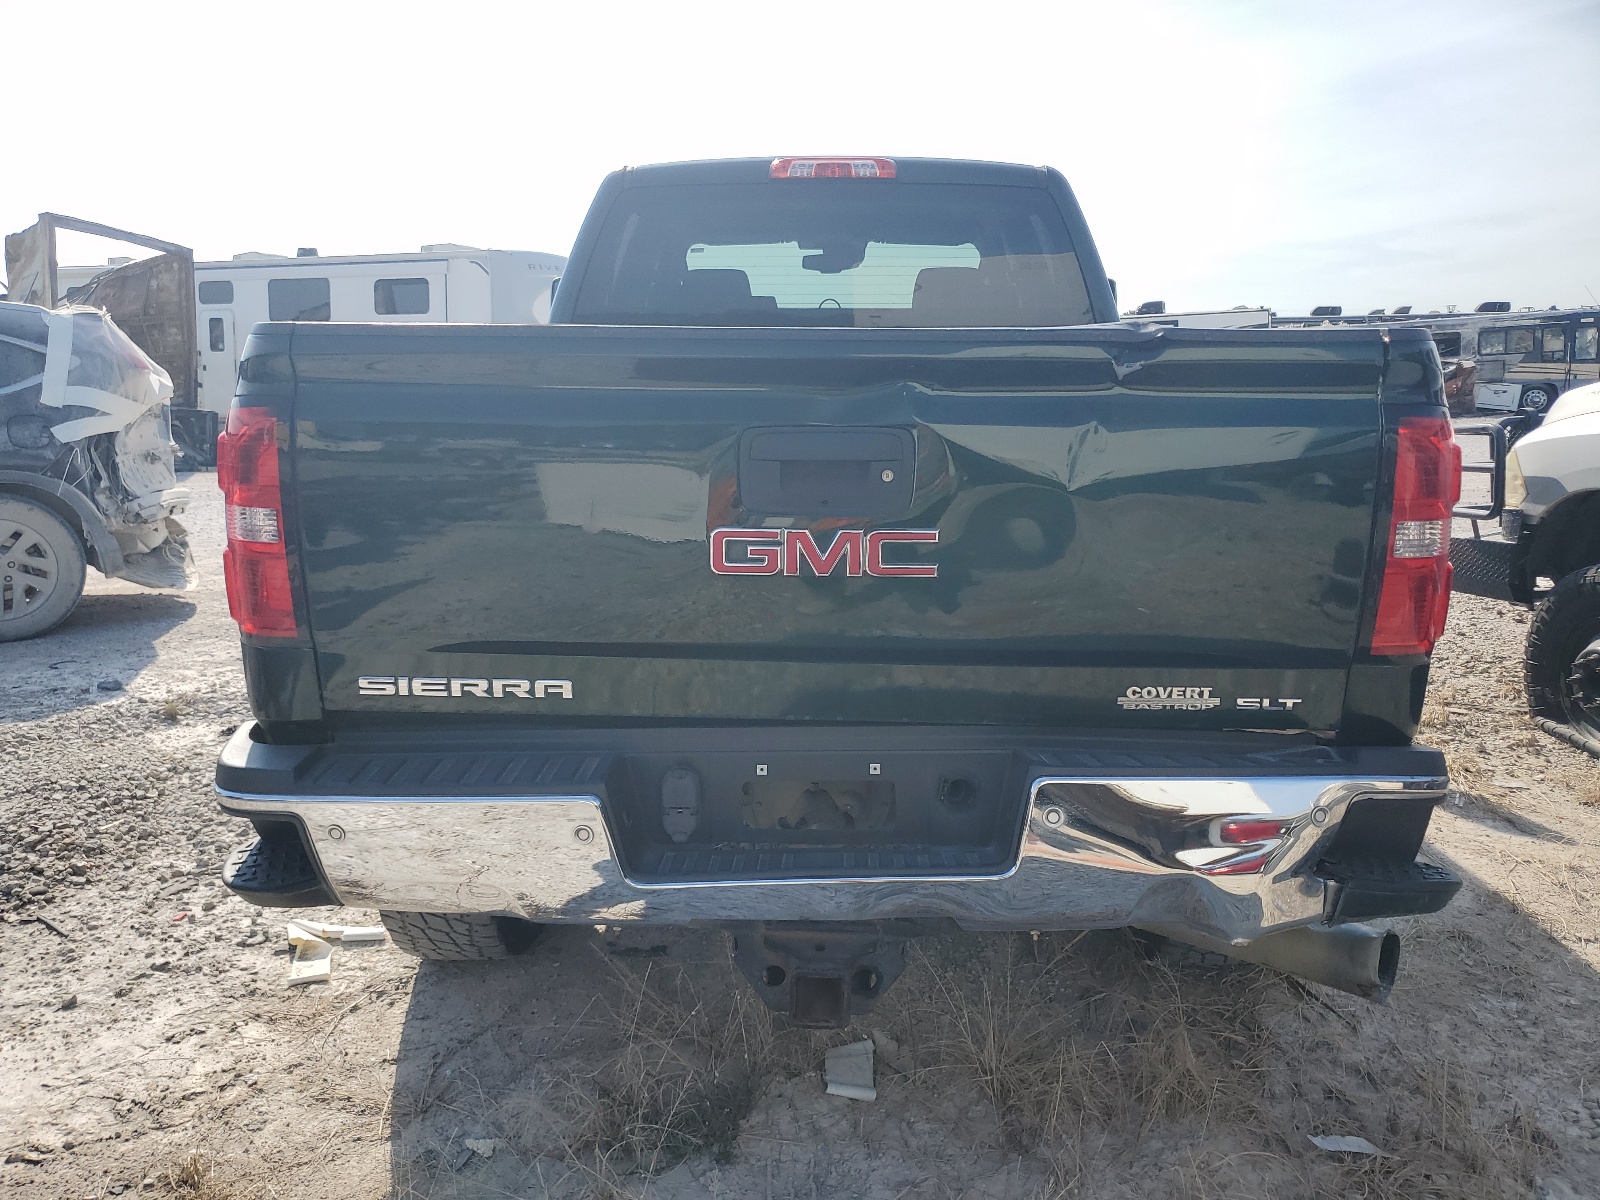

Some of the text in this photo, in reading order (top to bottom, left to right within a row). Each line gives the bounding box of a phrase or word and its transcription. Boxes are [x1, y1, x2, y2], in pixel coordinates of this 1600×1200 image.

[709, 527, 940, 578] GMC
[358, 676, 573, 699] SIERRA
[1126, 686, 1213, 699] COVERT
[1123, 703, 1215, 711] BASTROP
[1236, 698, 1302, 711] SLT
